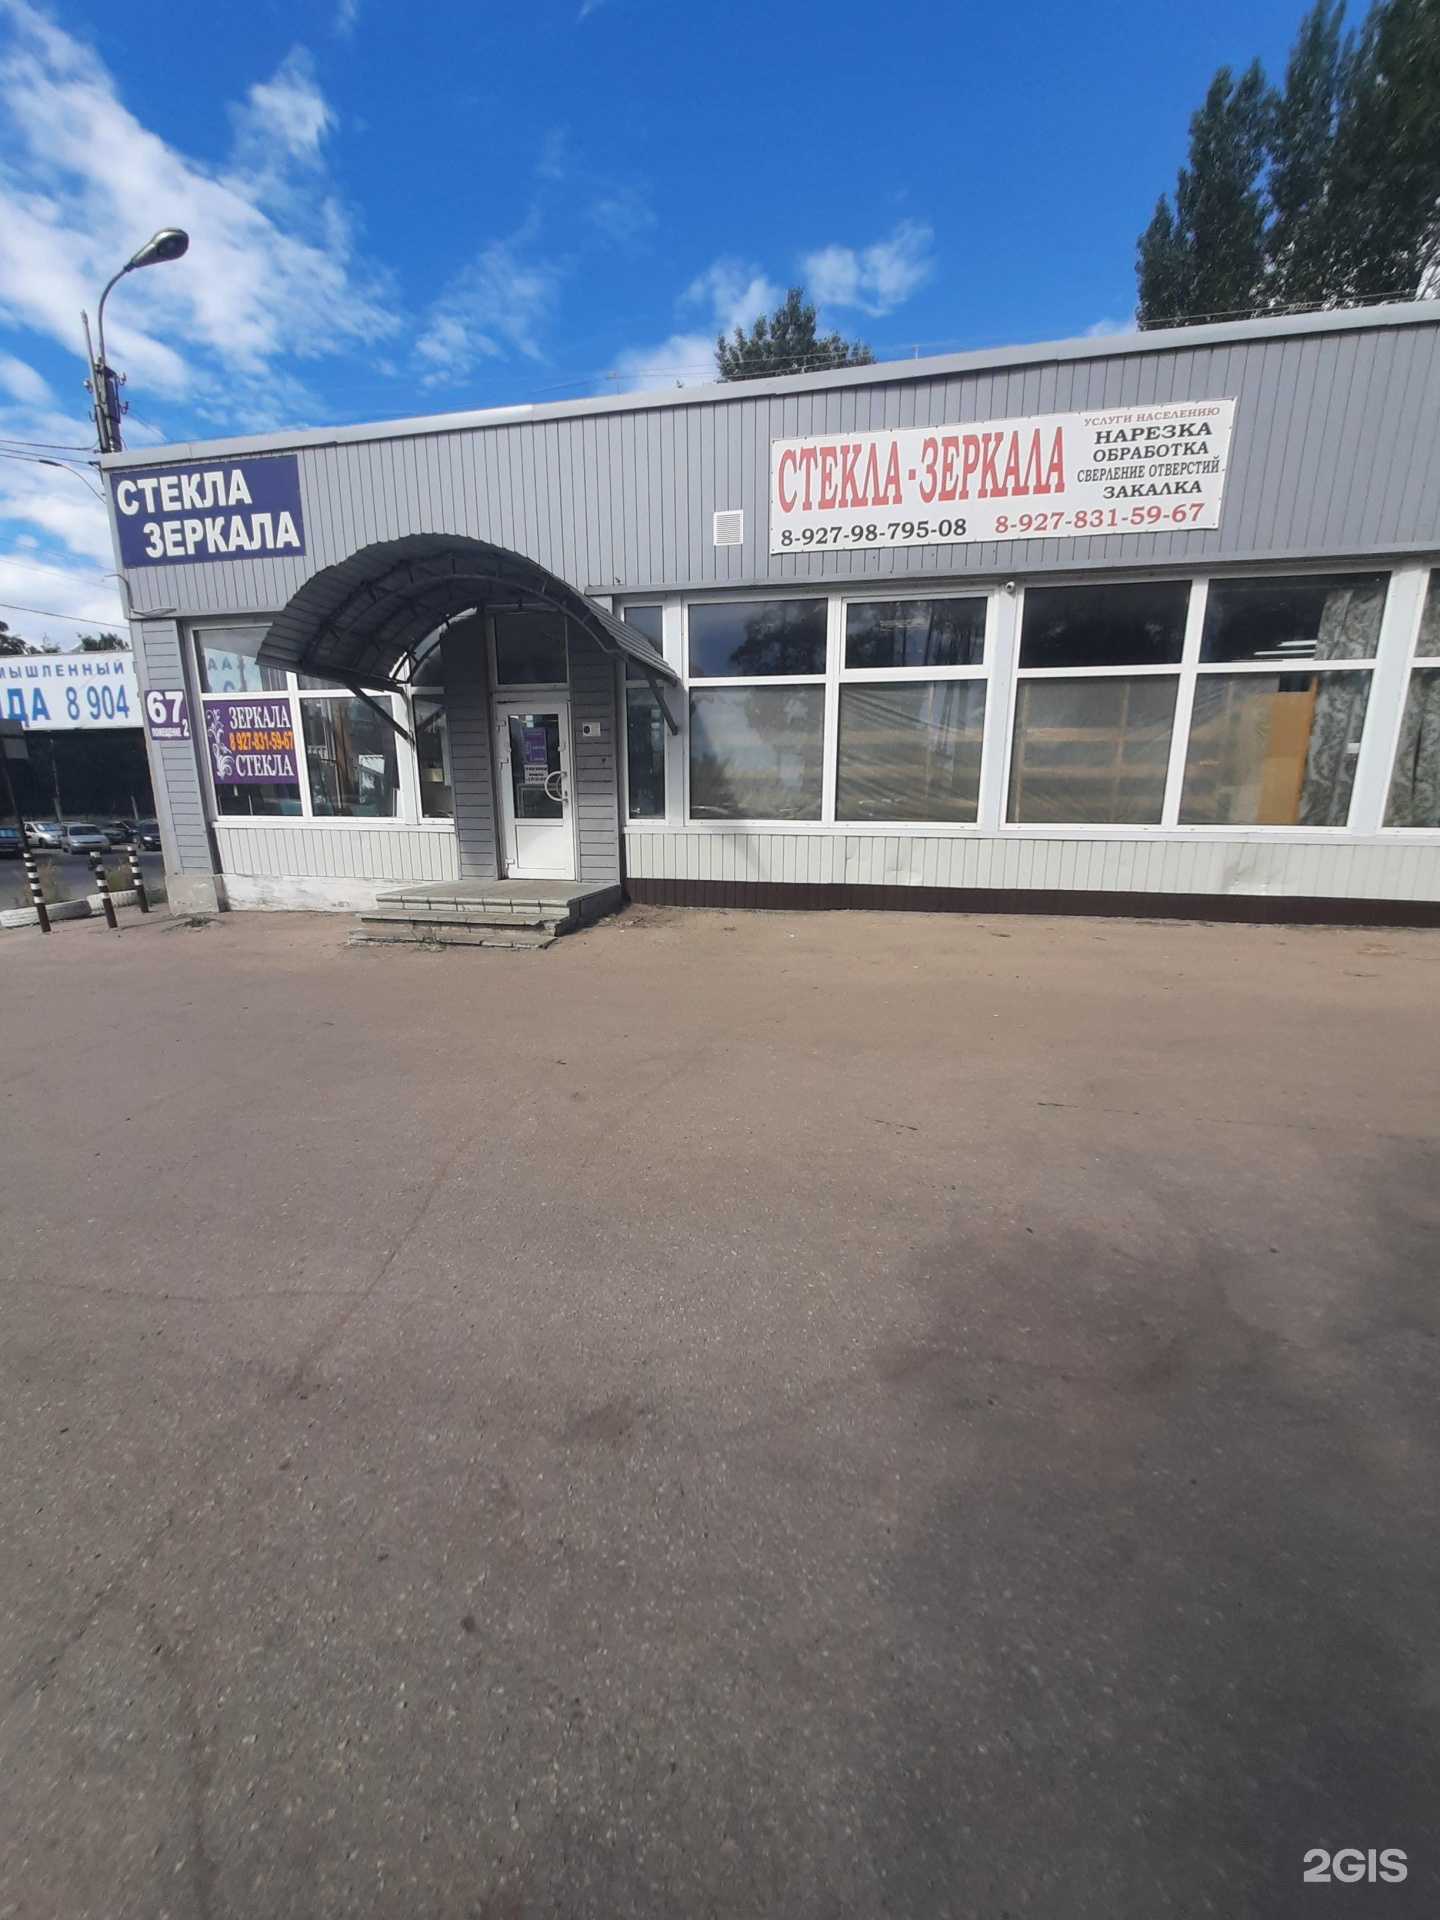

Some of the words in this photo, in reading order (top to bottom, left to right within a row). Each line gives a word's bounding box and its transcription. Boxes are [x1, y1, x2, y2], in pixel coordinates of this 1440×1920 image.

[1084, 413, 1133, 427] УСЛУГИ
[1136, 407, 1220, 422] НАСЕЛЕНИЮ
[1094, 421, 1213, 445] НАРЕЗКА
[1093, 441, 1209, 462] ОБРАБОТКА
[1077, 465, 1146, 483] СВЕРЛЕНИЕ
[1149, 455, 1220, 478] ОТВЕРСТИЙ
[117, 469, 253, 516] СТЕКЛА
[1103, 480, 1202, 499] ЗАКАЛКА
[780, 518, 967, 546] 8-927-98-795-08
[995, 502, 1205, 534] 8-927-831-59-67
[143, 511, 301, 558] ЗЕРКАЛА
[0, 685, 51, 728] ДА
[65, 686, 81, 721] 8
[86, 684, 130, 720] 904
[147, 691, 184, 724] 67
[228, 705, 291, 729] ЗЕРКАЛА
[235, 754, 295, 777] СТЕКЛА
